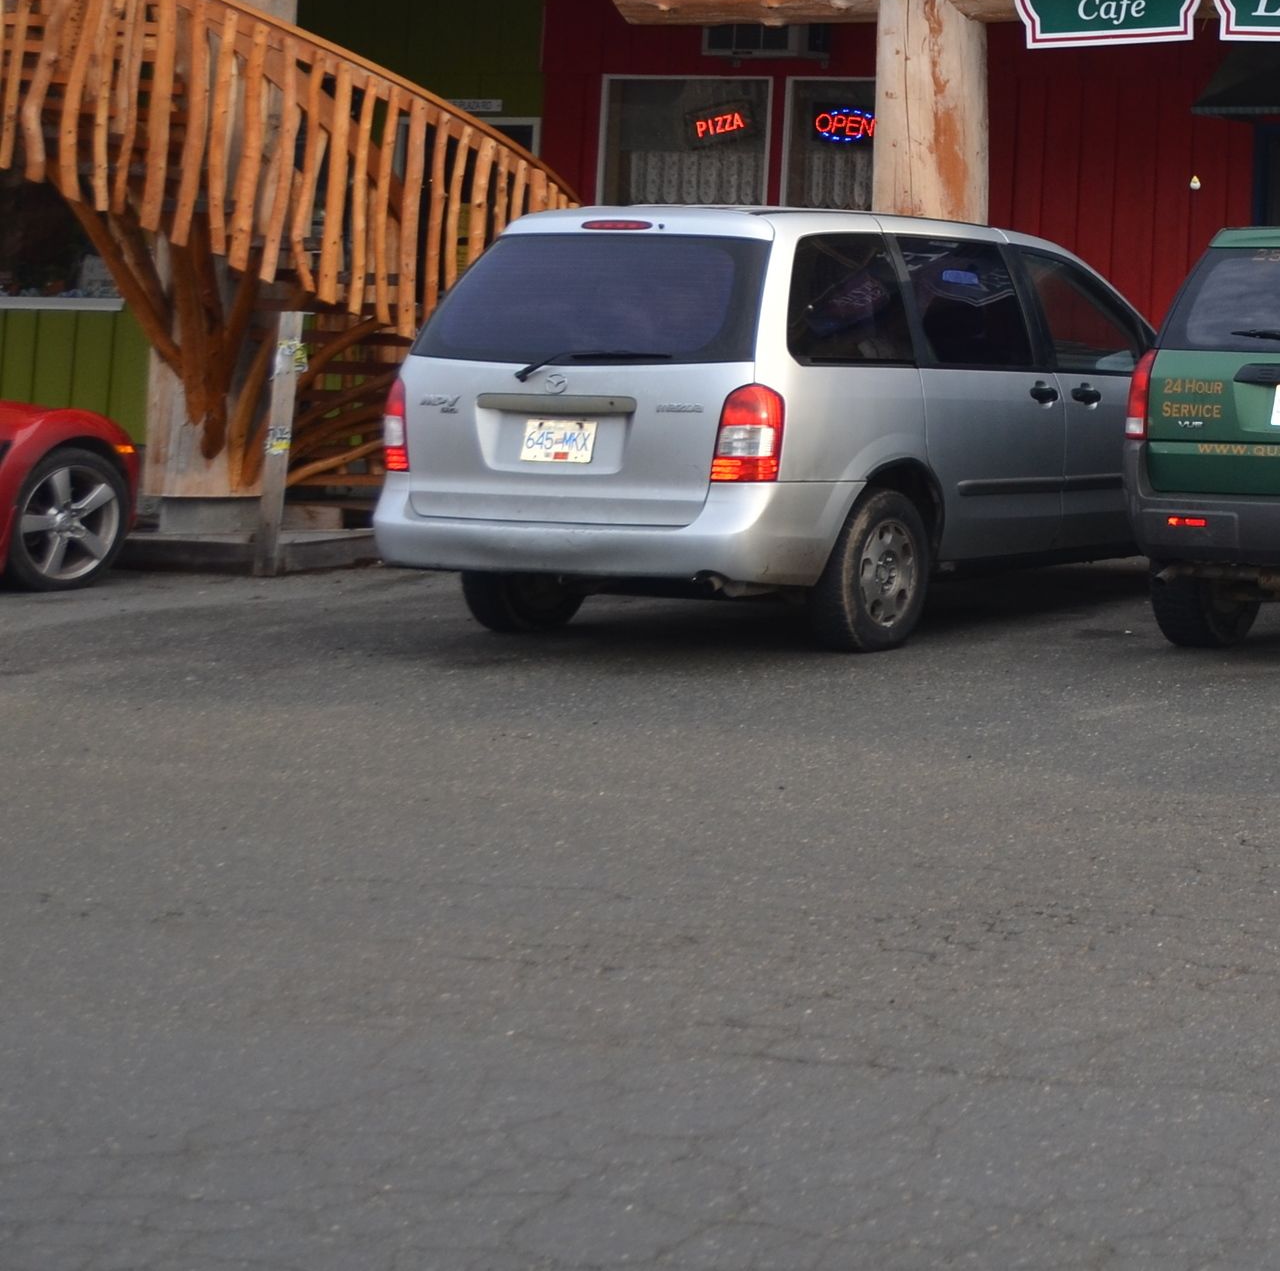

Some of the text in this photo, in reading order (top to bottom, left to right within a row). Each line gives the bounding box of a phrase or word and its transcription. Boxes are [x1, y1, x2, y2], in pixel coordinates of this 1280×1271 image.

[696, 112, 744, 138] PIZZA
[815, 113, 876, 137] OPEN
[1164, 378, 1223, 394] 24 HOUR
[1162, 402, 1222, 418] SERVICE
[525, 430, 553, 449] 645
